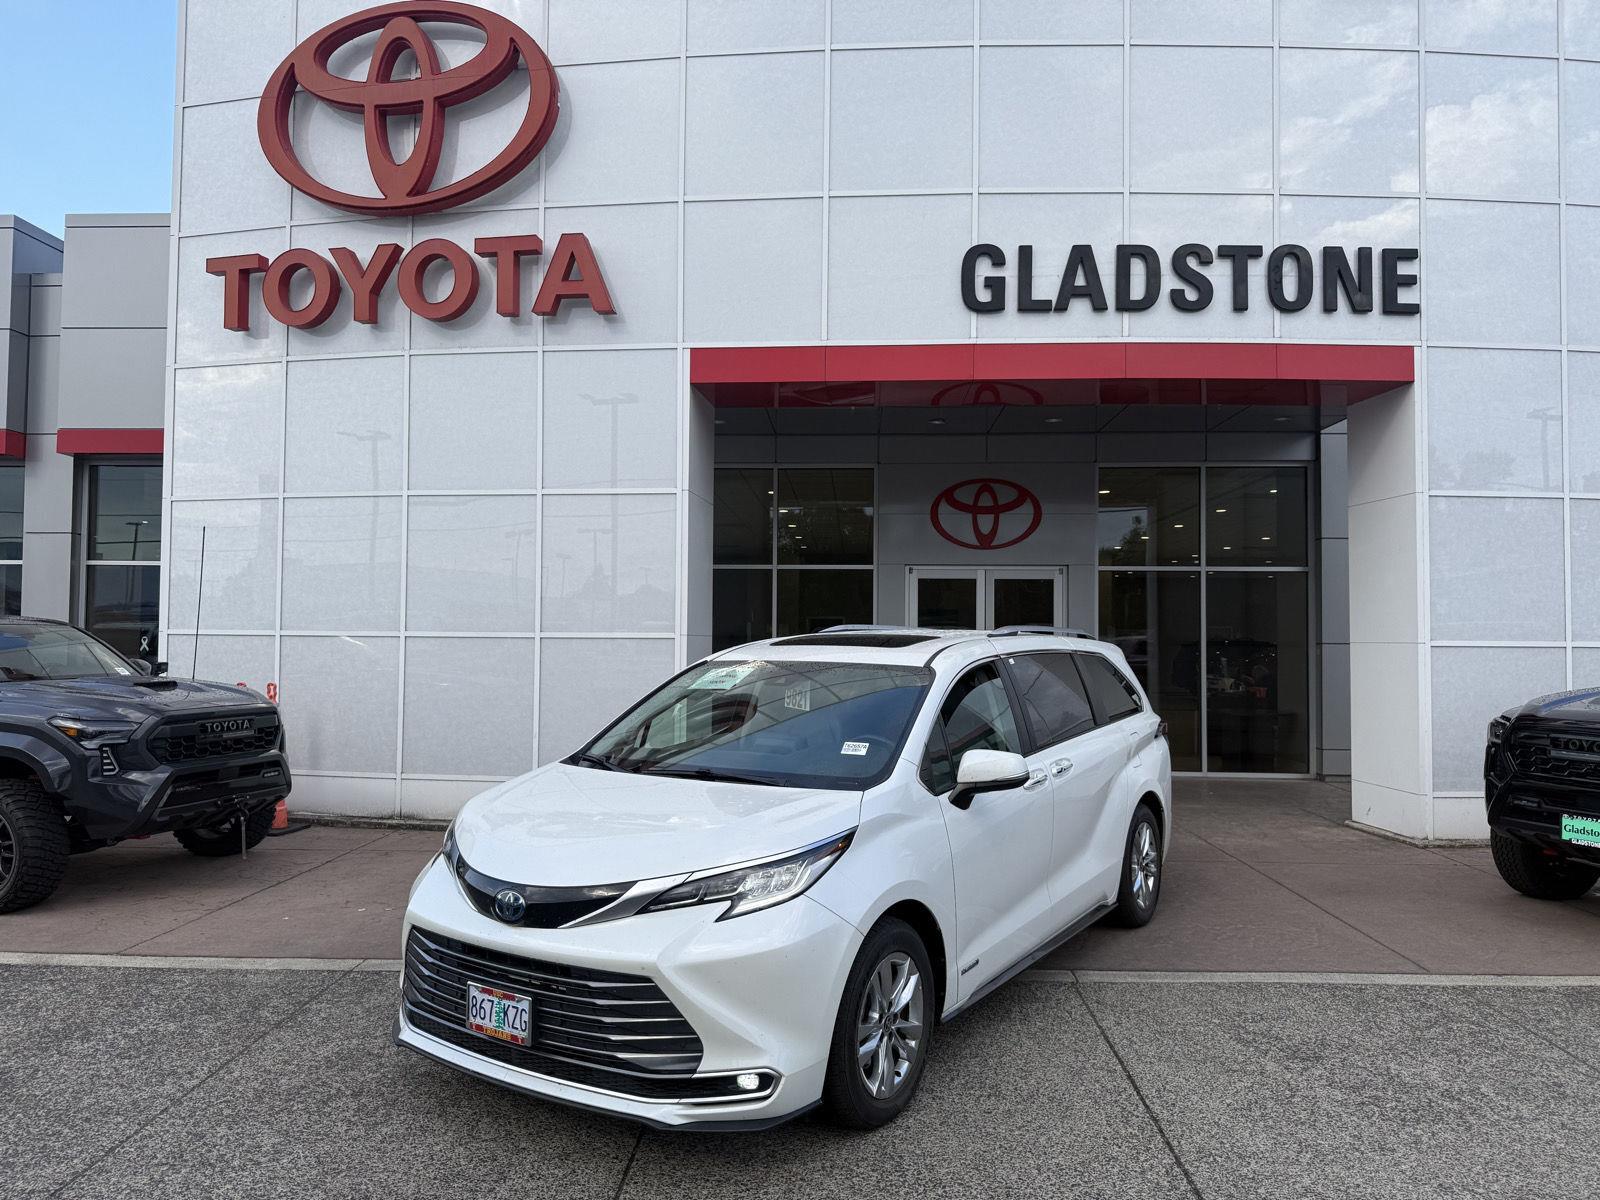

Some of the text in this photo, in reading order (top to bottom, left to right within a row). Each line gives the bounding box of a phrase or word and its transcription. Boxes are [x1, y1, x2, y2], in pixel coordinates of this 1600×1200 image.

[206, 233, 616, 332] TOYOTA
[961, 243, 1420, 315] GLADSTONE
[205, 720, 250, 732] TOYOTA
[1573, 815, 1600, 823] TOYOT
[471, 995, 528, 1032] 867 KZG
